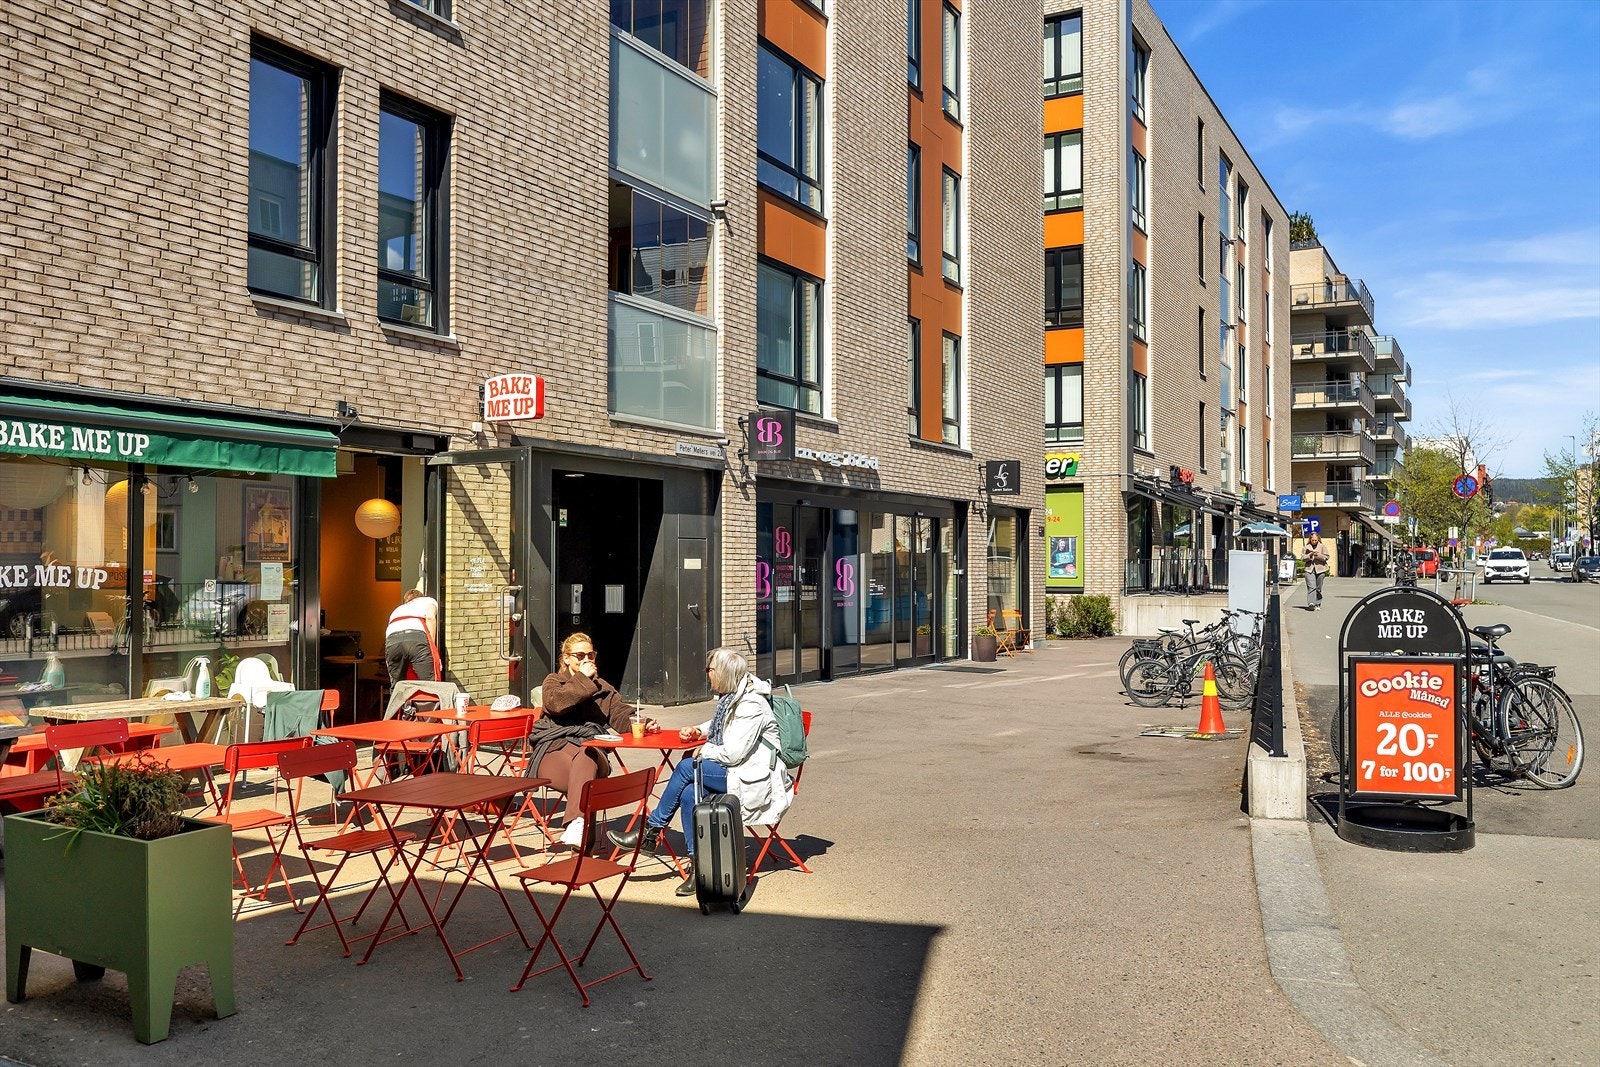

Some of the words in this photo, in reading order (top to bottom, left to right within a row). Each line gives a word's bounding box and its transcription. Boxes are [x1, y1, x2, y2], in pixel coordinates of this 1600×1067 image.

[488, 376, 532, 398] BAKE
[487, 399, 510, 418] ME
[513, 397, 534, 415] UP
[71, 427, 112, 454] ME
[116, 431, 150, 457] UP
[1311, 520, 1319, 531] P
[33, 565, 72, 588] ME
[77, 567, 108, 590] UP
[1378, 608, 1425, 624] BAKE
[1377, 624, 1403, 639] ME
[1405, 624, 1428, 639] UP
[1361, 670, 1443, 697] Cookie
[1410, 689, 1450, 709] Måned
[1379, 710, 1400, 718] ALLE
[1361, 759, 1376, 780] 7
[1380, 765, 1399, 778] for
